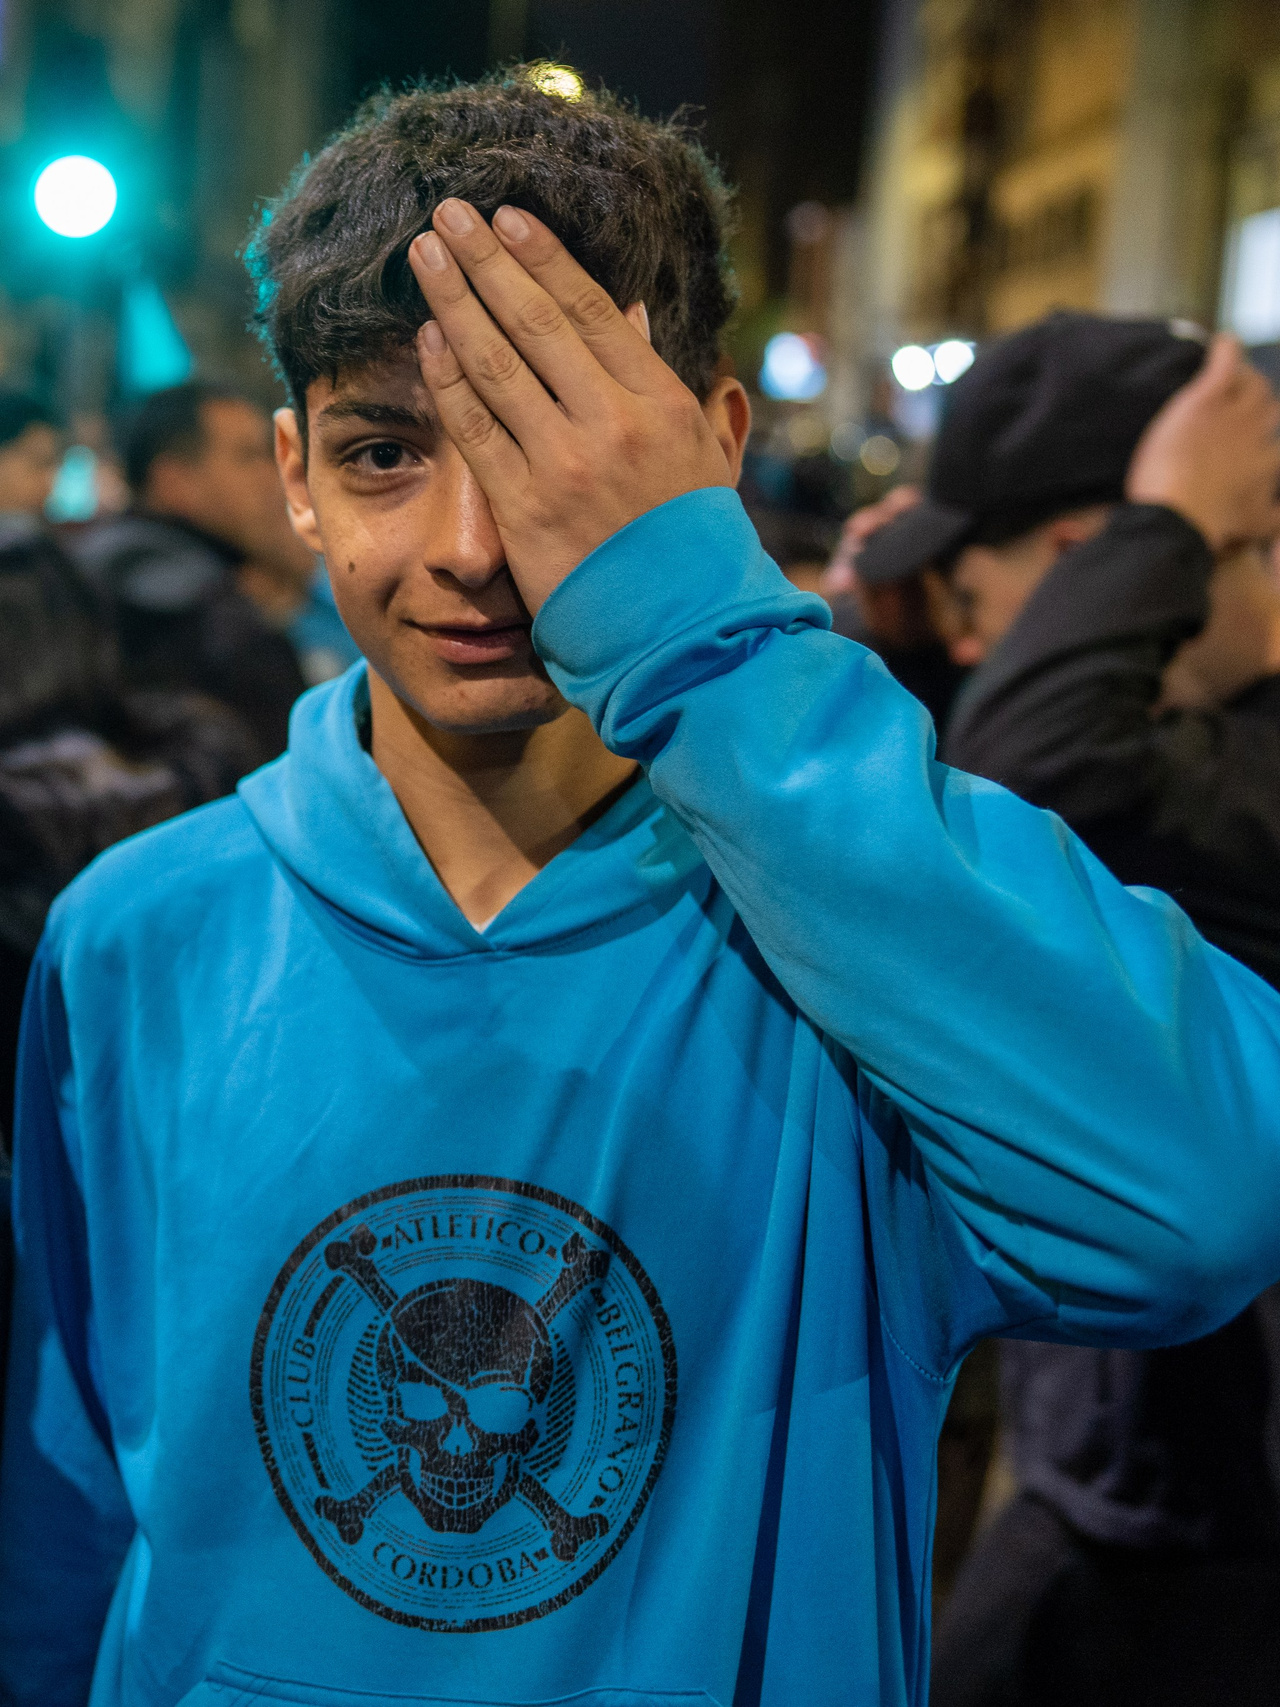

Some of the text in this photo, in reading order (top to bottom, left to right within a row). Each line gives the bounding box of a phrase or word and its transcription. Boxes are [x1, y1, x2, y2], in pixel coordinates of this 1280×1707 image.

[287, 1214, 645, 1493] CLUB ATLETICO BELGRANO
[372, 1542, 539, 1589] CORDOBA
